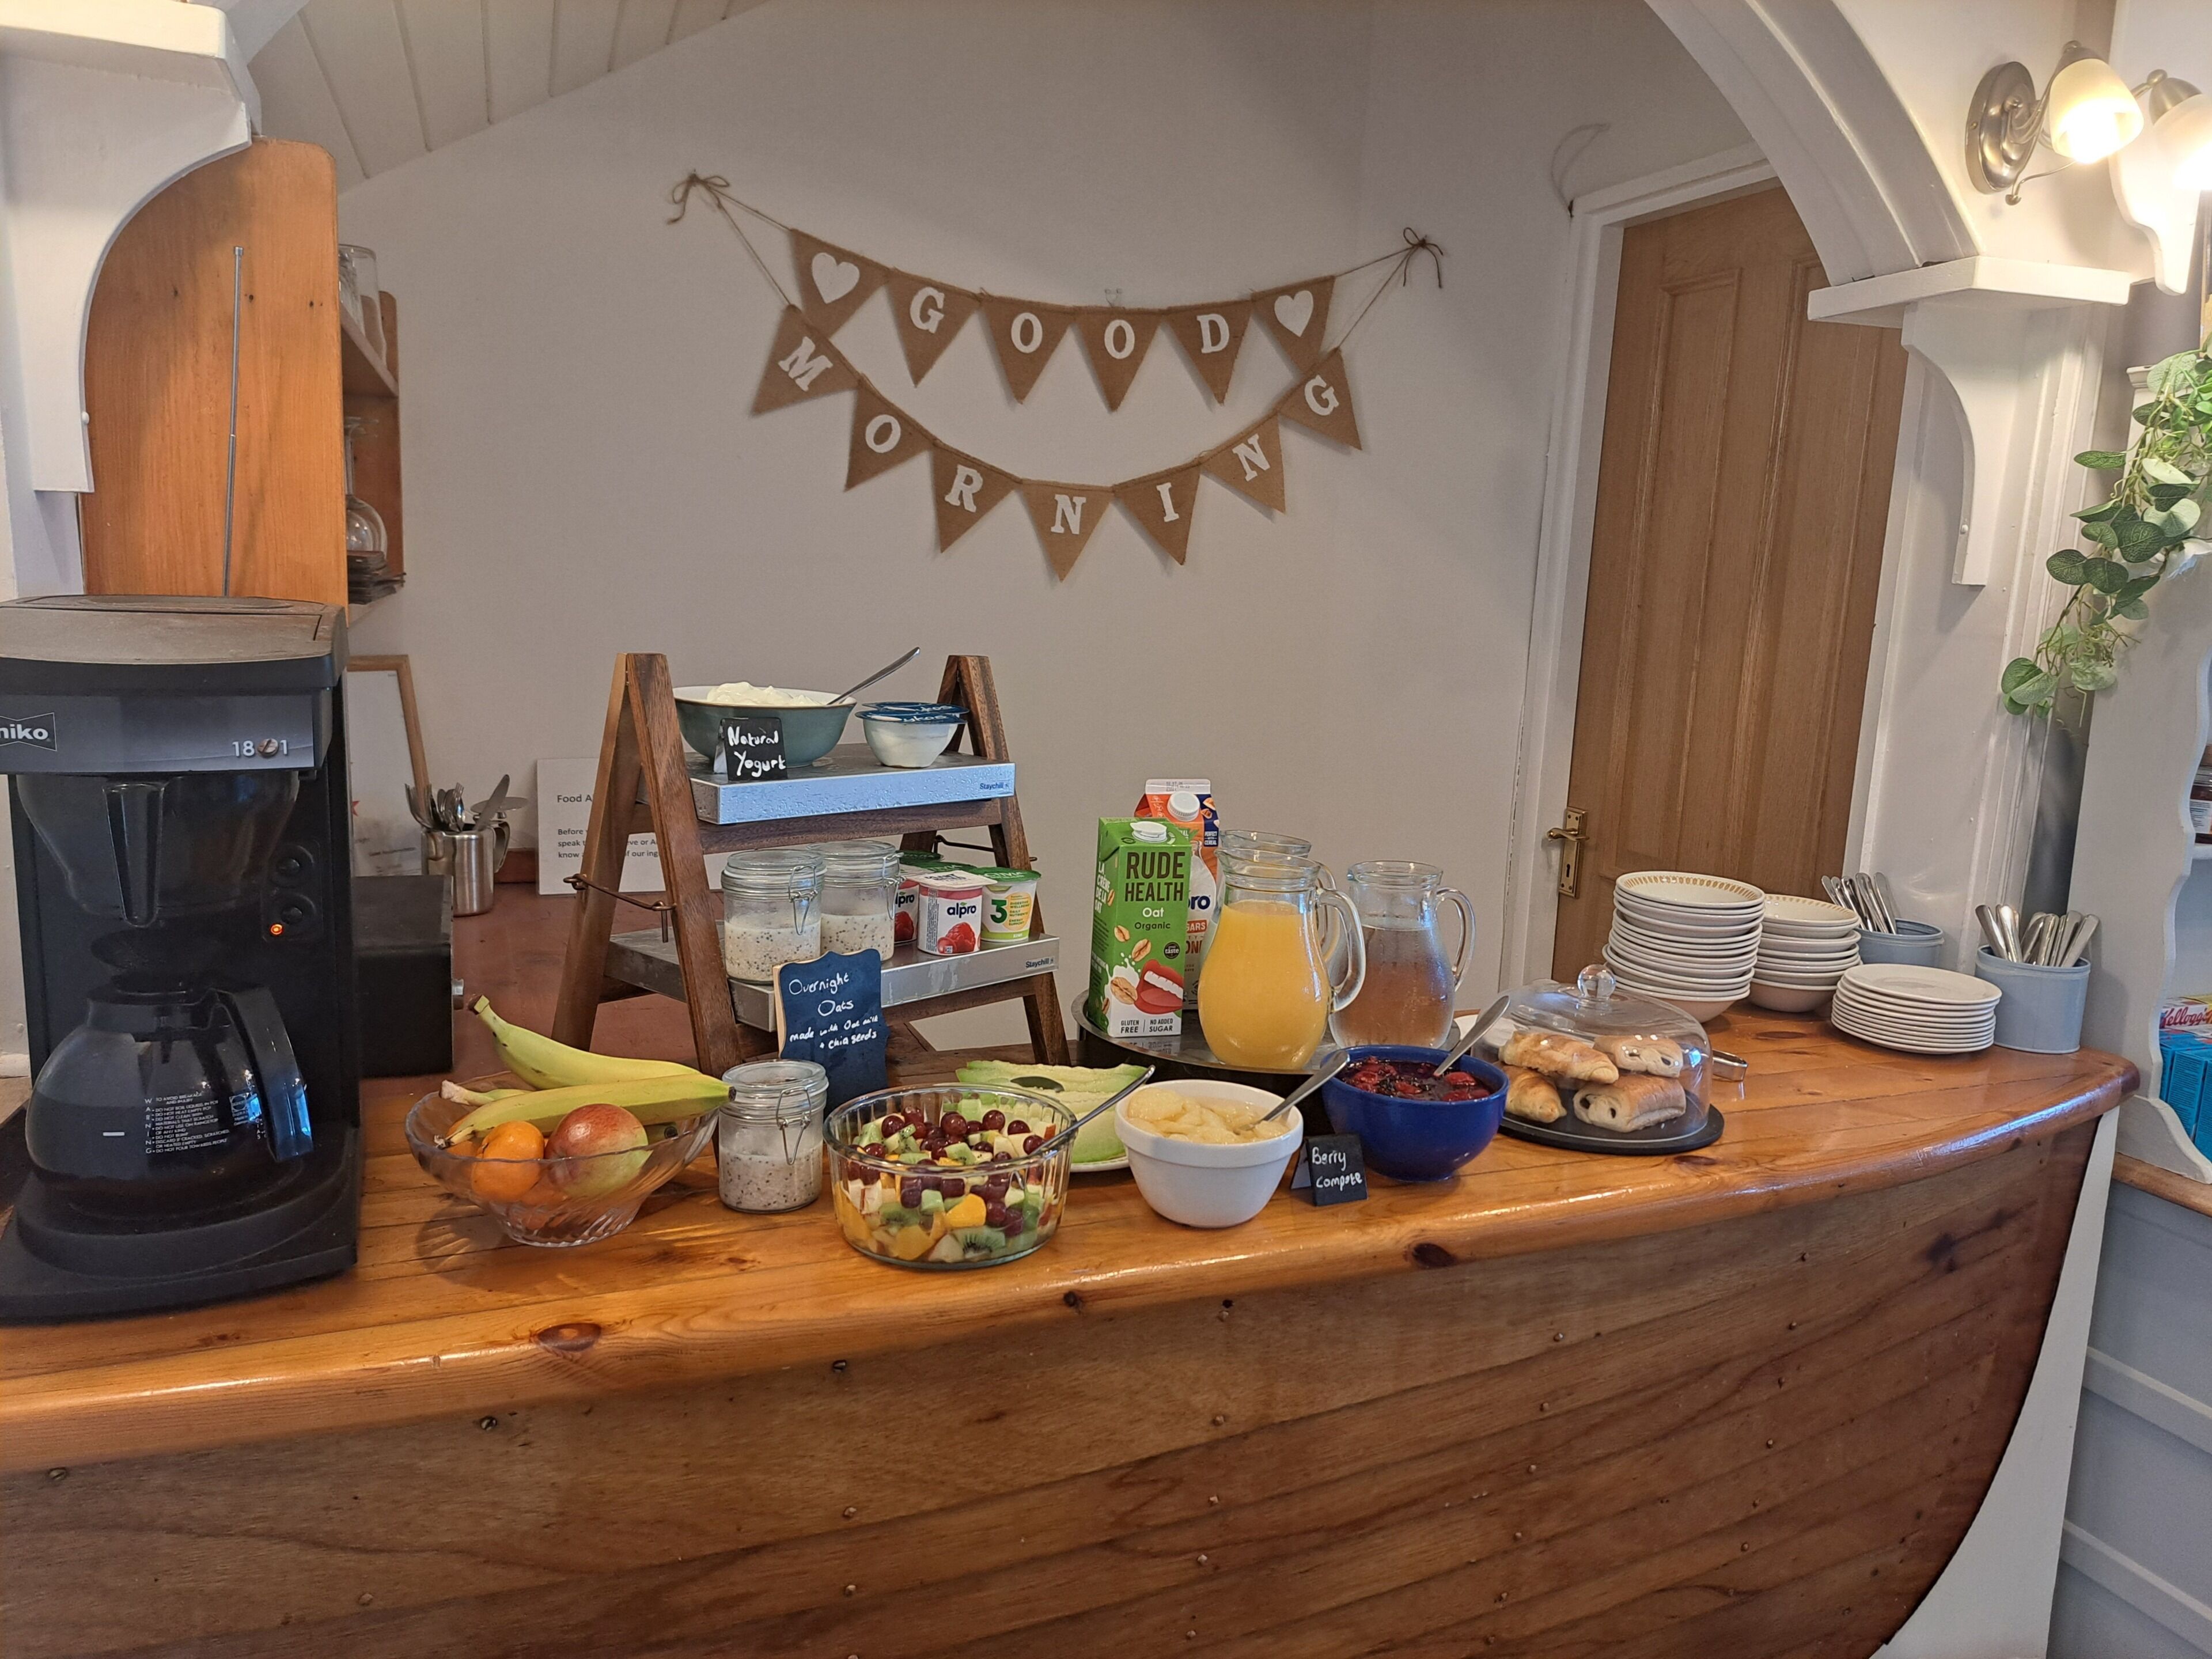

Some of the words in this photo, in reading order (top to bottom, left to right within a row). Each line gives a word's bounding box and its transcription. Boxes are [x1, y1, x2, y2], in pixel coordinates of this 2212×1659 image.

[910, 287, 1230, 359] GOOD
[778, 336, 1339, 535] MORNING
[728, 726, 779, 747] Natural
[734, 751, 786, 777] Yogurt
[557, 794, 582, 802] Food
[1126, 851, 1185, 880] RUDE
[1124, 881, 1184, 902] HEALTH
[947, 903, 977, 918] alpro
[990, 899, 1007, 923] 3
[1142, 907, 1164, 918] Oat
[1134, 922, 1171, 931] Organic
[1026, 958, 1050, 968] Staychill
[789, 972, 850, 995] Overnight
[817, 999, 854, 1017] Oats
[789, 1027, 815, 1043] made
[820, 1023, 838, 1036] with
[862, 1014, 878, 1025] milk
[851, 1028, 877, 1044] seeds
[1312, 1146, 1346, 1172] Berry
